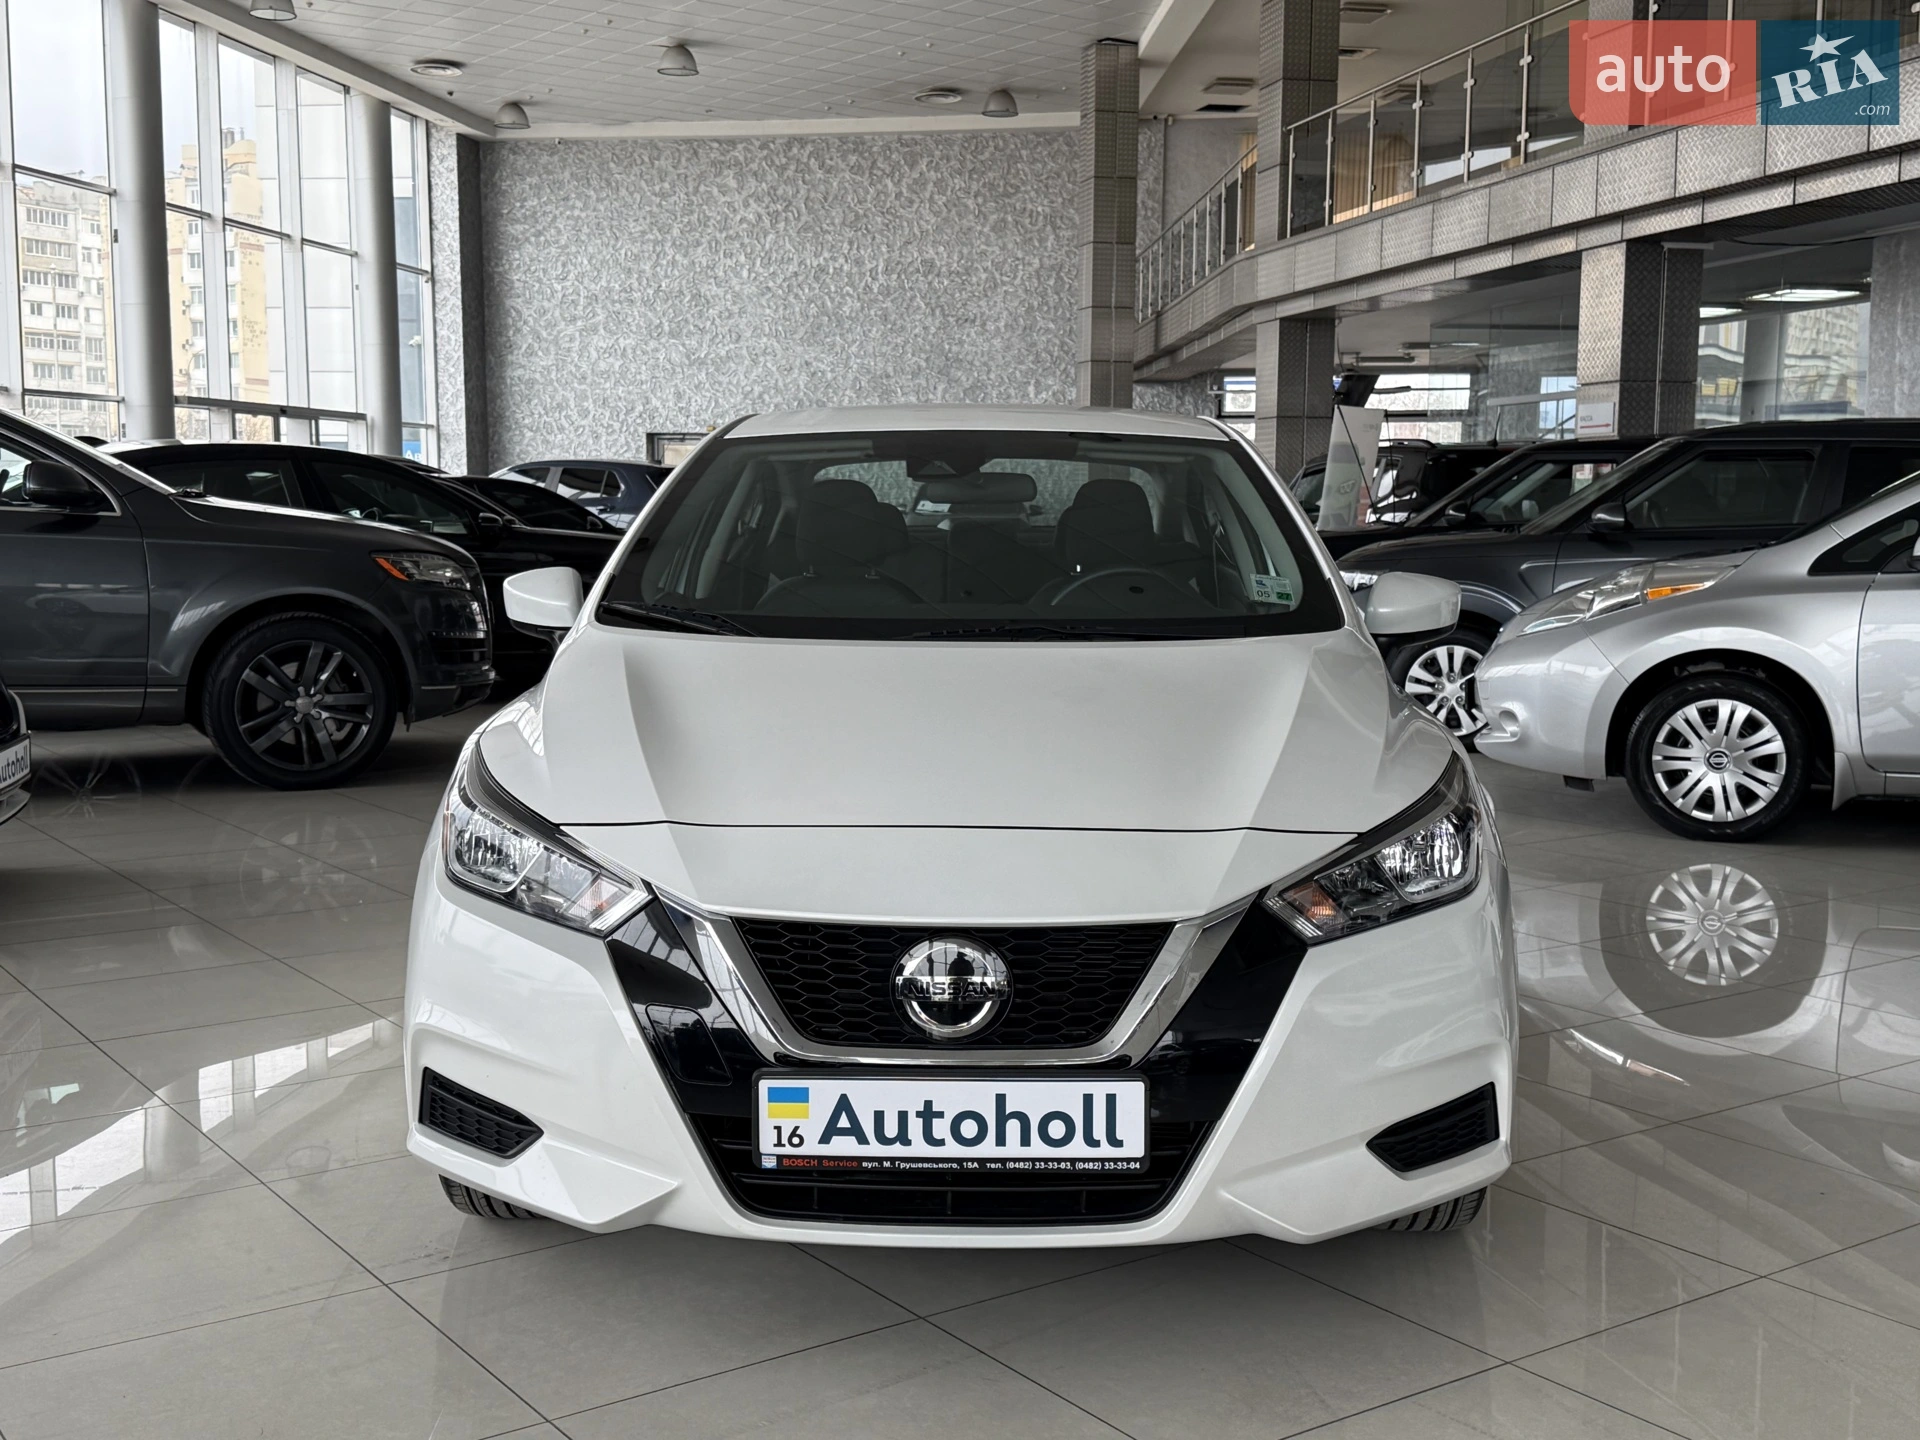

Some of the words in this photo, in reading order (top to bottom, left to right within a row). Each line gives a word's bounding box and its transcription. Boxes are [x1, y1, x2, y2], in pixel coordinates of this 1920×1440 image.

[1256, 590, 1270, 598] 05
[0, 744, 28, 784] utoholl
[907, 981, 996, 997] NISSAN
[817, 1093, 1124, 1149] Autoholl
[772, 1125, 805, 1149] 16
[782, 1158, 818, 1167] BOSCH
[822, 1159, 858, 1167] Service
[862, 1161, 881, 1169] вул.
[883, 1160, 893, 1168] М.
[895, 1161, 960, 1170] Грушевського,
[1006, 1161, 1032, 1170] (0482)
[1075, 1161, 1102, 1170] (0482)
[1103, 1161, 1141, 1170] 33-33-04
